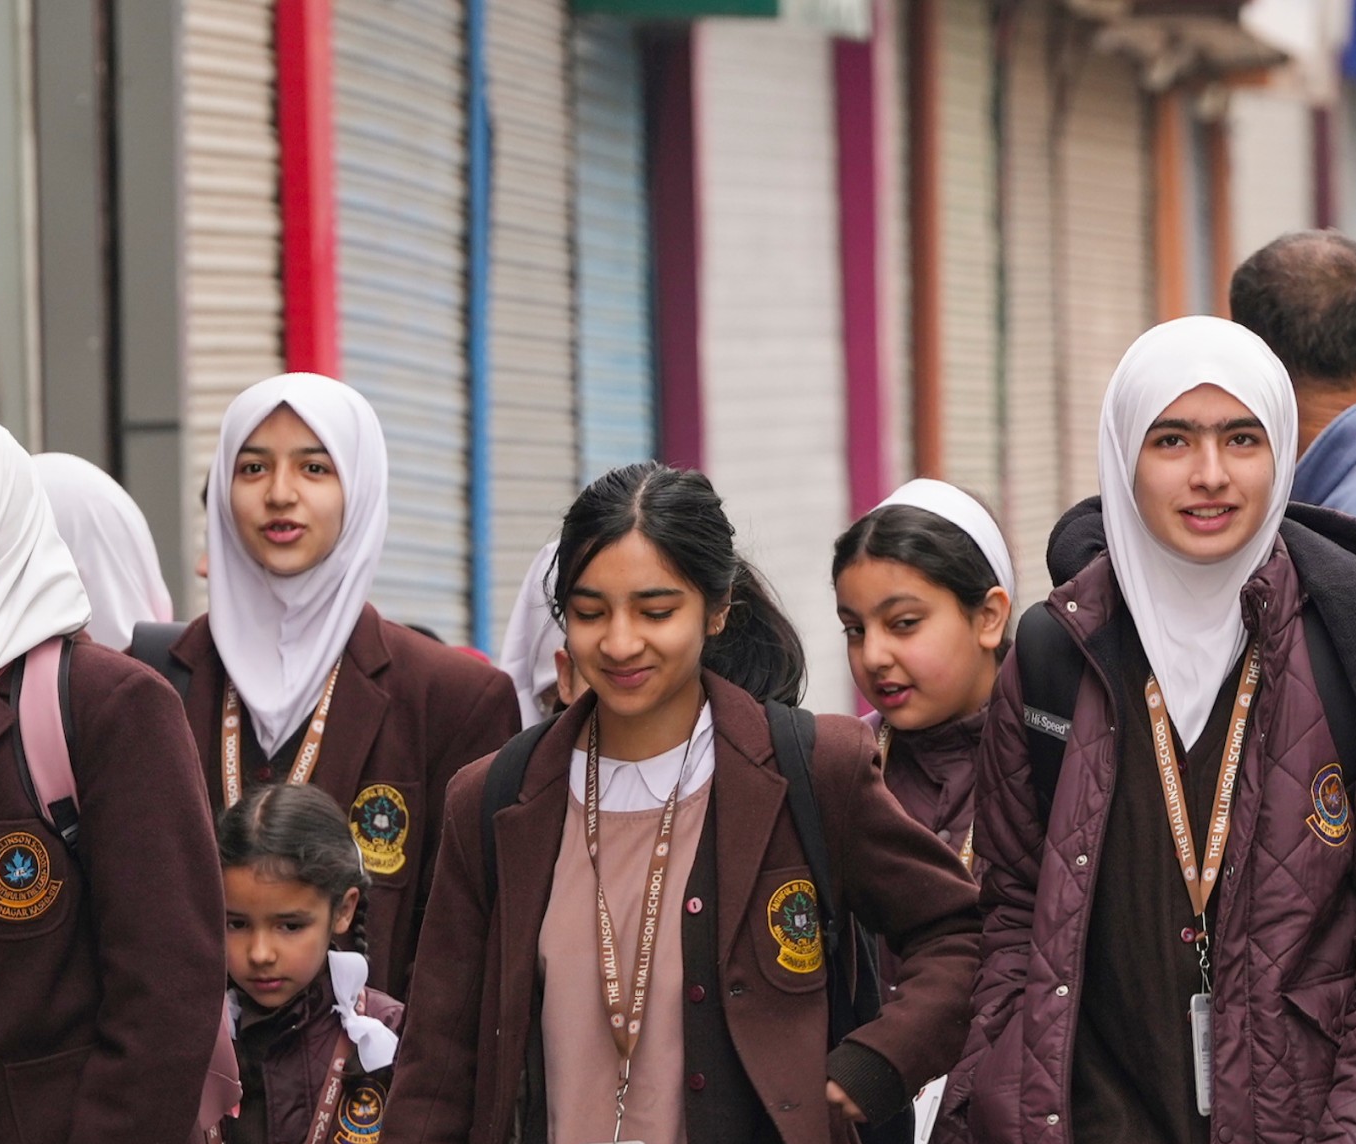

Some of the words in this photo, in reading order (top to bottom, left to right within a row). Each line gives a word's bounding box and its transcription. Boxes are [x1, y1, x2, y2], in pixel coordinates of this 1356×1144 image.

[1245, 658, 1260, 685] THE
[227, 690, 238, 711] THE
[226, 733, 237, 769] SCHOOL
[1155, 716, 1172, 766] SCHOOL
[1228, 718, 1247, 763] SCHOOL
[293, 741, 317, 785] SCHOOL
[588, 747, 597, 812] MALLINSON
[1163, 767, 1186, 837] MALLINSON
[1213, 765, 1238, 834] MALLINSON
[588, 811, 597, 836] THE
[661, 811, 674, 837] THE
[1178, 835, 1191, 862] THE
[1209, 834, 1223, 859] THE
[647, 866, 664, 916] SCHOOL
[600, 911, 618, 979] MALLINSON
[634, 917, 656, 990] MALLINSON
[607, 981, 620, 1006] THE
[632, 990, 646, 1014] THE
[324, 1077, 340, 1105] THE
